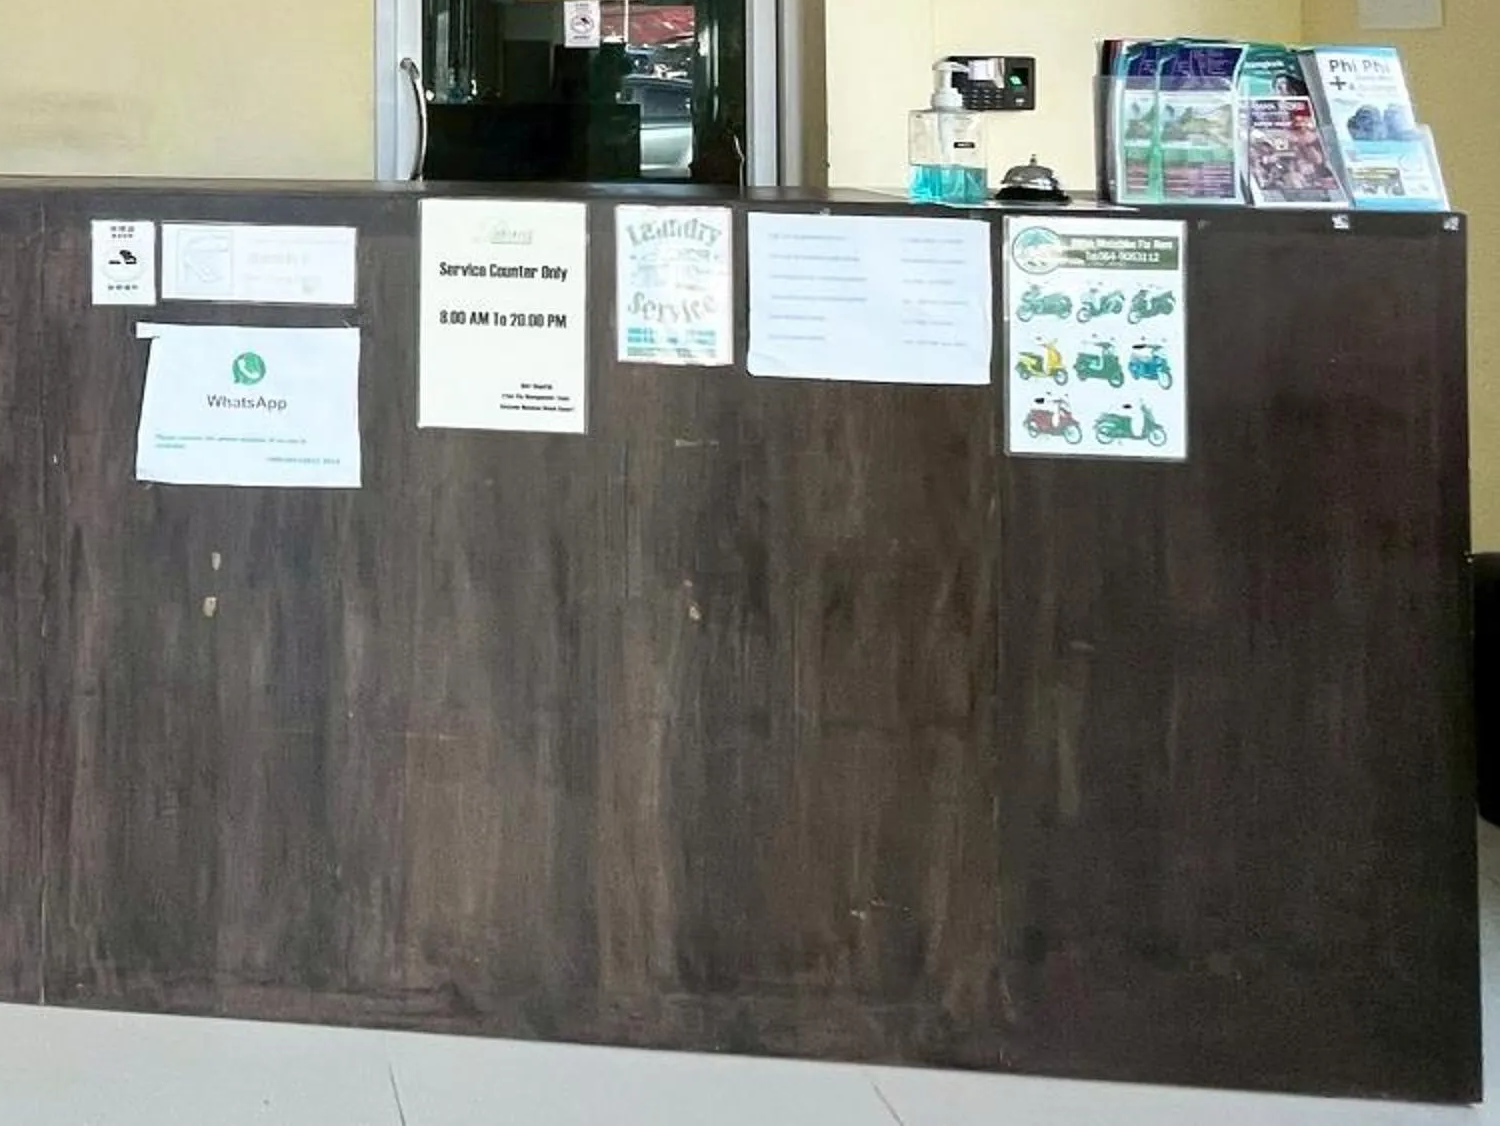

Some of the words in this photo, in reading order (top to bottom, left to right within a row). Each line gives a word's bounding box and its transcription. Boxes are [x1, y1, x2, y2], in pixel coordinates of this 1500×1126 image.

[1329, 59, 1357, 73] Phi
[1362, 59, 1390, 74] Phi
[439, 262, 486, 278] Service
[489, 263, 538, 279] Counter
[541, 265, 568, 282] Only
[627, 291, 716, 324] Service
[469, 311, 489, 326] AM
[493, 312, 507, 326] To
[547, 314, 567, 328] PM
[207, 394, 287, 411] WhatsApp
